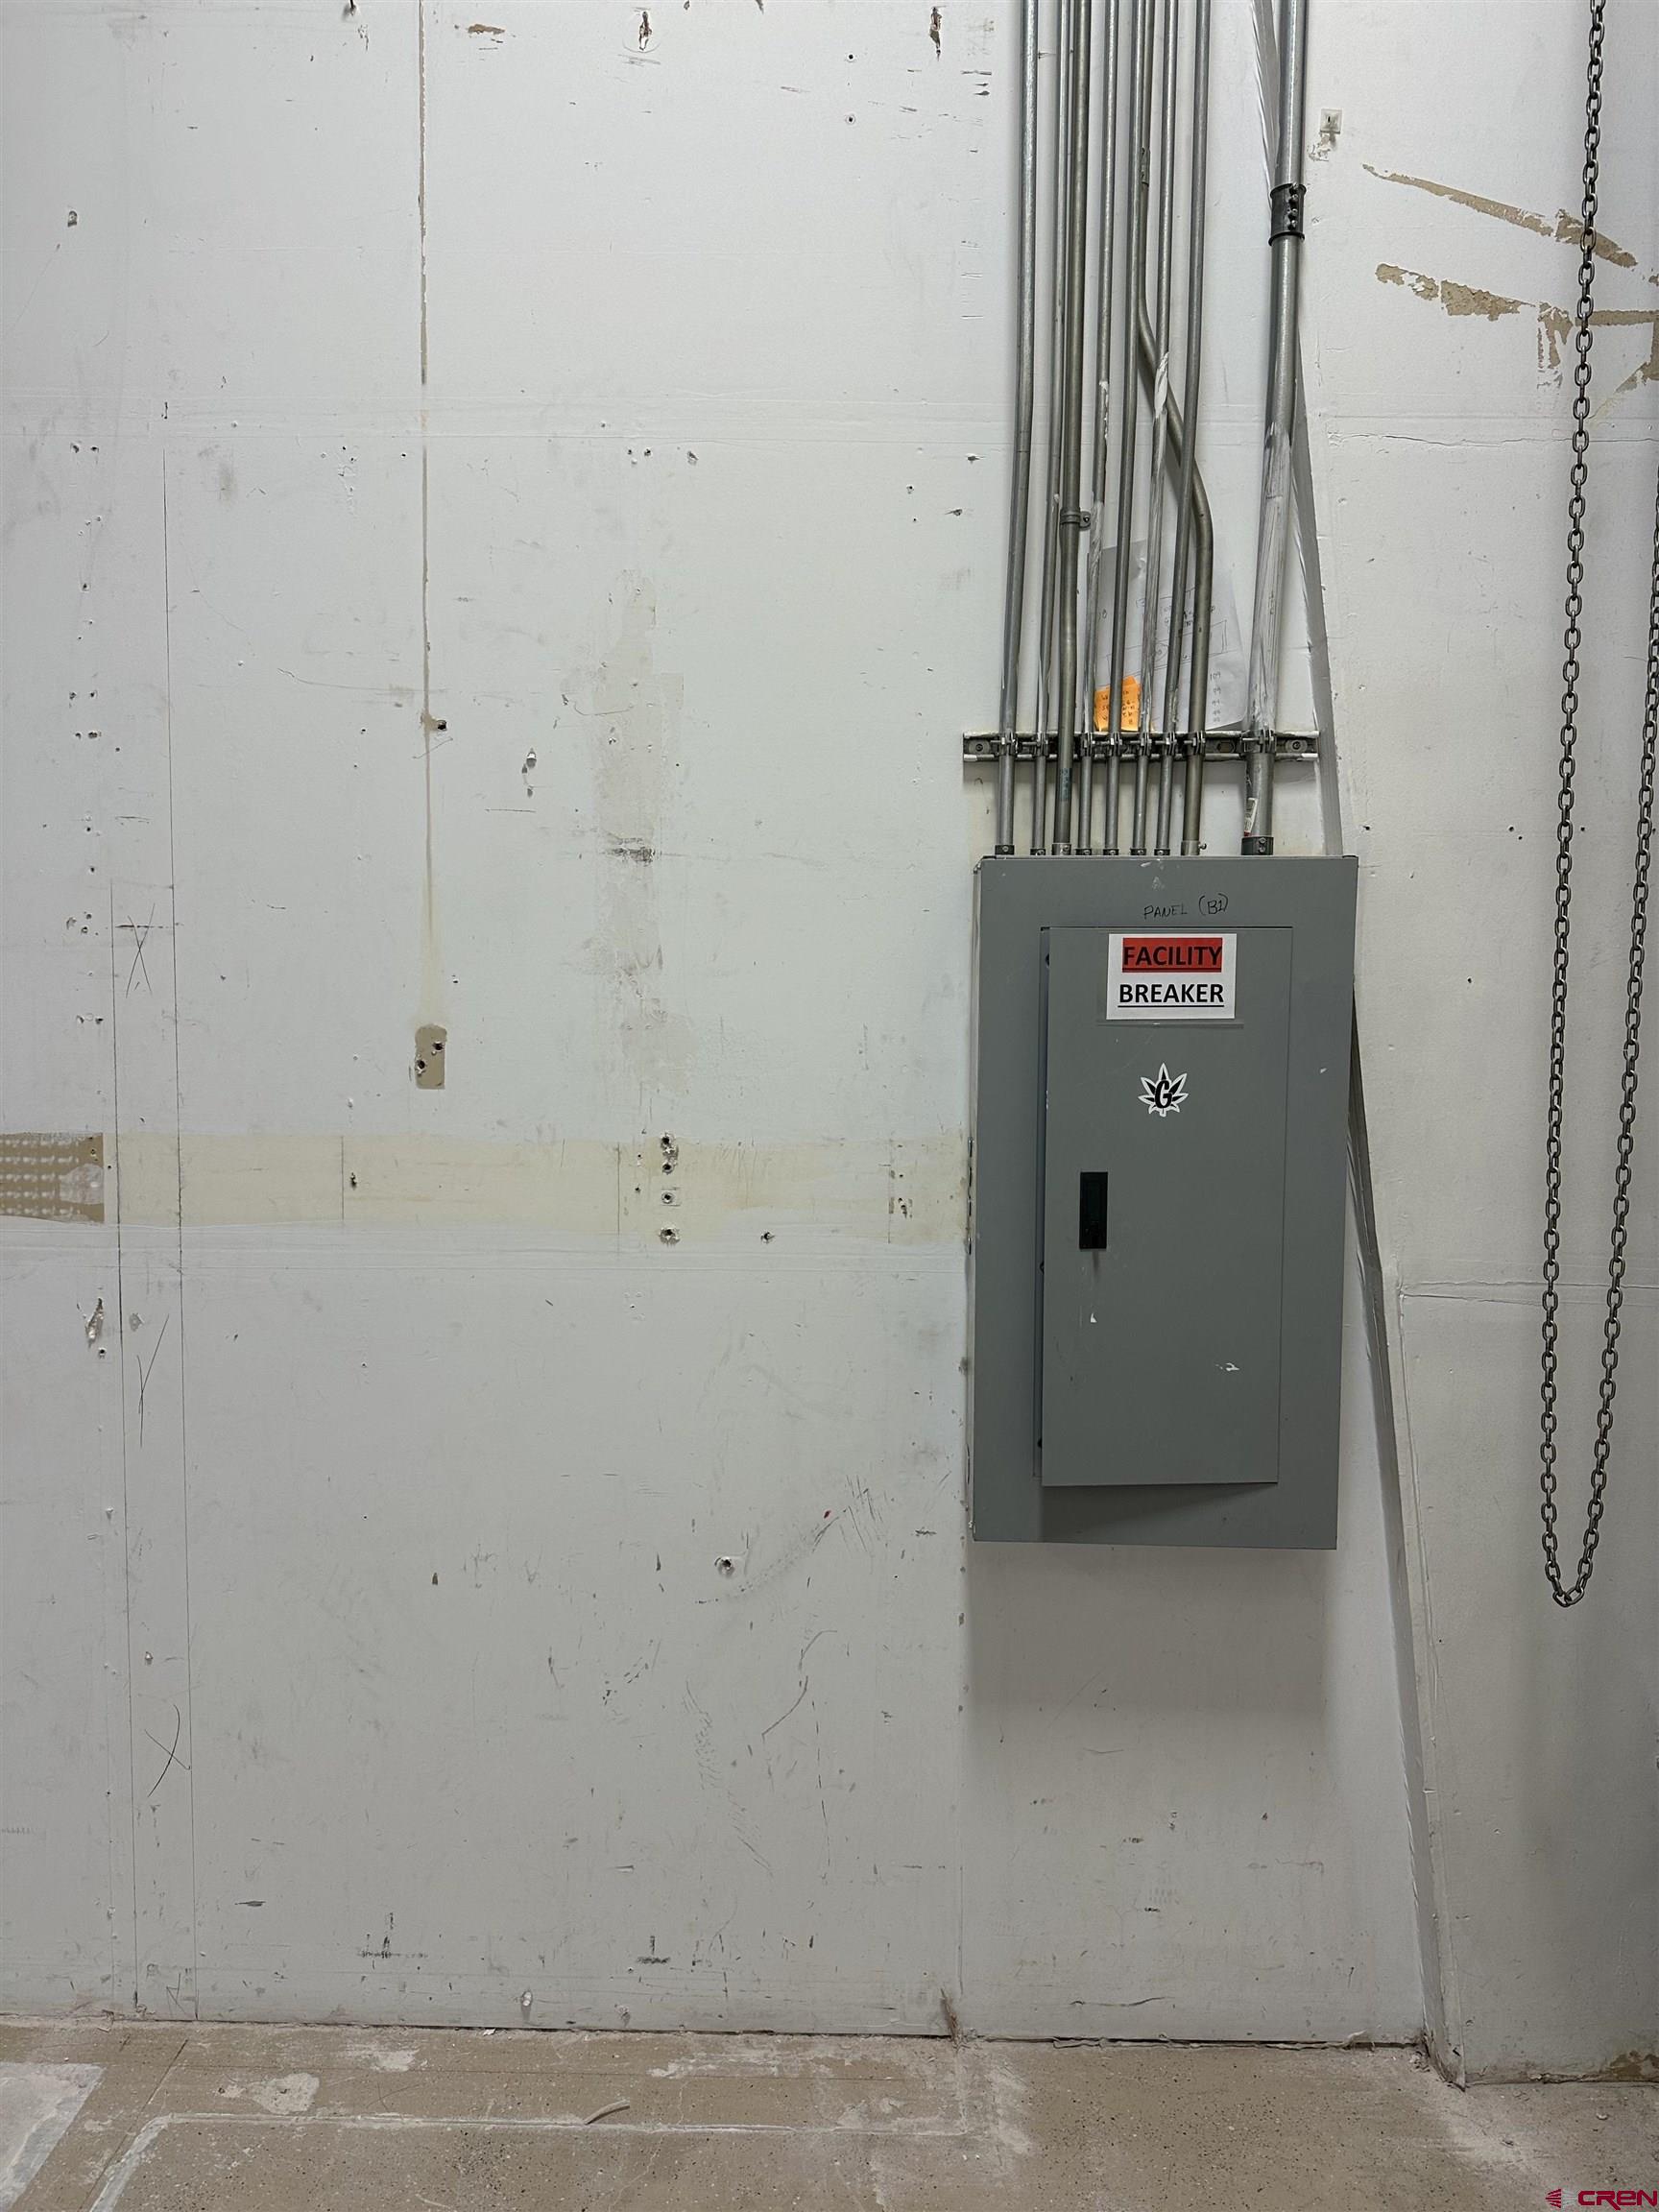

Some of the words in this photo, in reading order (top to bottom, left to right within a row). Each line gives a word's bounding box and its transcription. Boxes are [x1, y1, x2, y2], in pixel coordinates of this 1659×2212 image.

[1142, 902, 1188, 920] PANEL
[1122, 946, 1222, 966] FACILITY
[1118, 983, 1224, 1003] BREAKER
[1154, 1079, 1172, 1109] G
